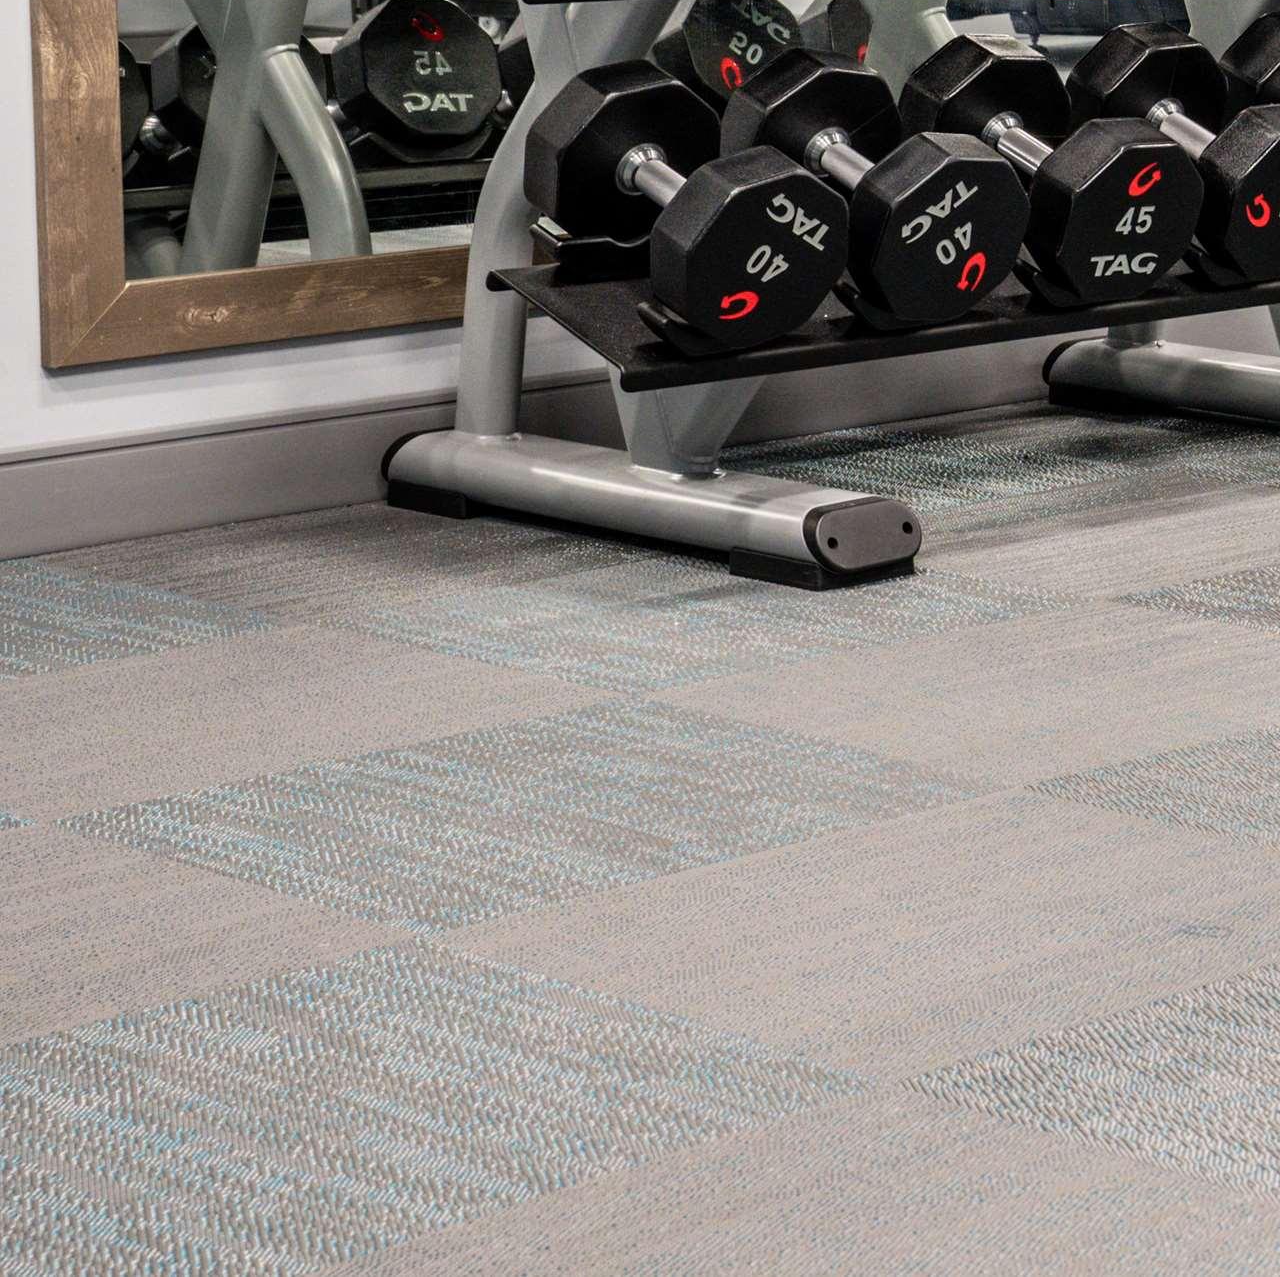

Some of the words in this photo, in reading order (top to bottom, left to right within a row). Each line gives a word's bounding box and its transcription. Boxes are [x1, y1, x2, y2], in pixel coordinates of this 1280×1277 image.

[767, 194, 829, 251] TAG
[901, 180, 979, 244] TAG
[1115, 206, 1155, 235] 45
[936, 222, 972, 264] 40
[747, 245, 789, 282] 40
[1091, 253, 1158, 276] TAG
